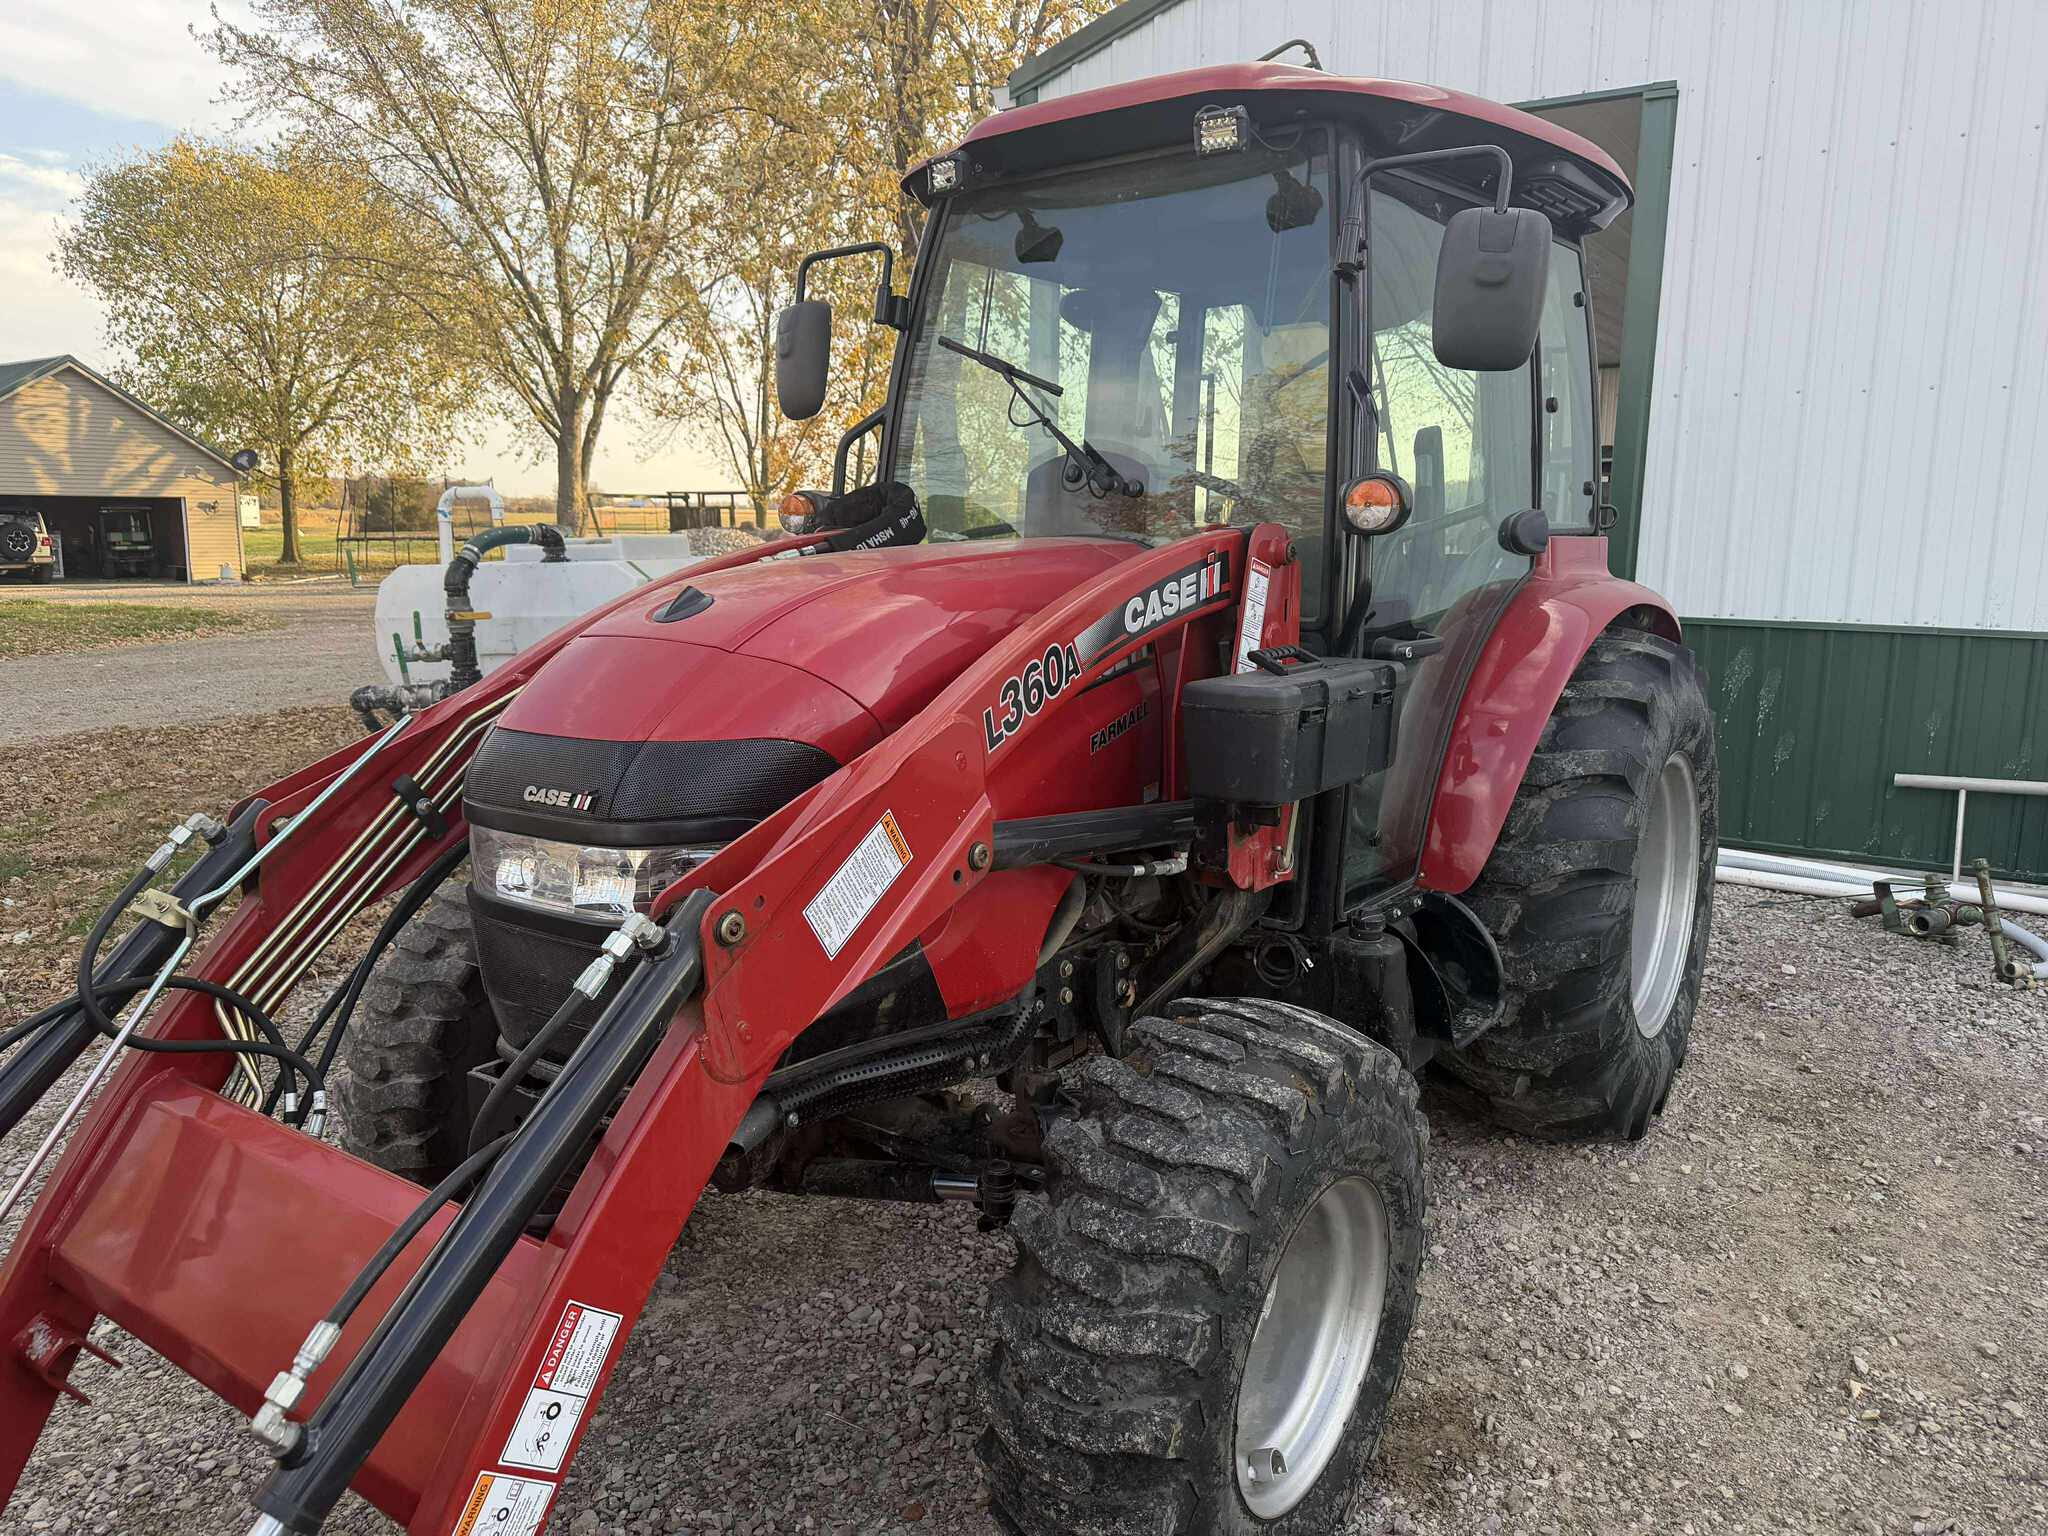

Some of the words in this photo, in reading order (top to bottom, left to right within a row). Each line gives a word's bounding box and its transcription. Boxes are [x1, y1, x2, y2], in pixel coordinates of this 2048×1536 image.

[867, 526, 895, 548] MSHA
[1124, 572, 1198, 634] CASE
[983, 642, 1082, 754] L360A
[1090, 701, 1151, 756] FARMALL
[523, 785, 572, 807] CASE
[888, 826, 907, 859] WARNING
[547, 1310, 577, 1367] DANGER
[458, 1483, 488, 1536] WARNING
